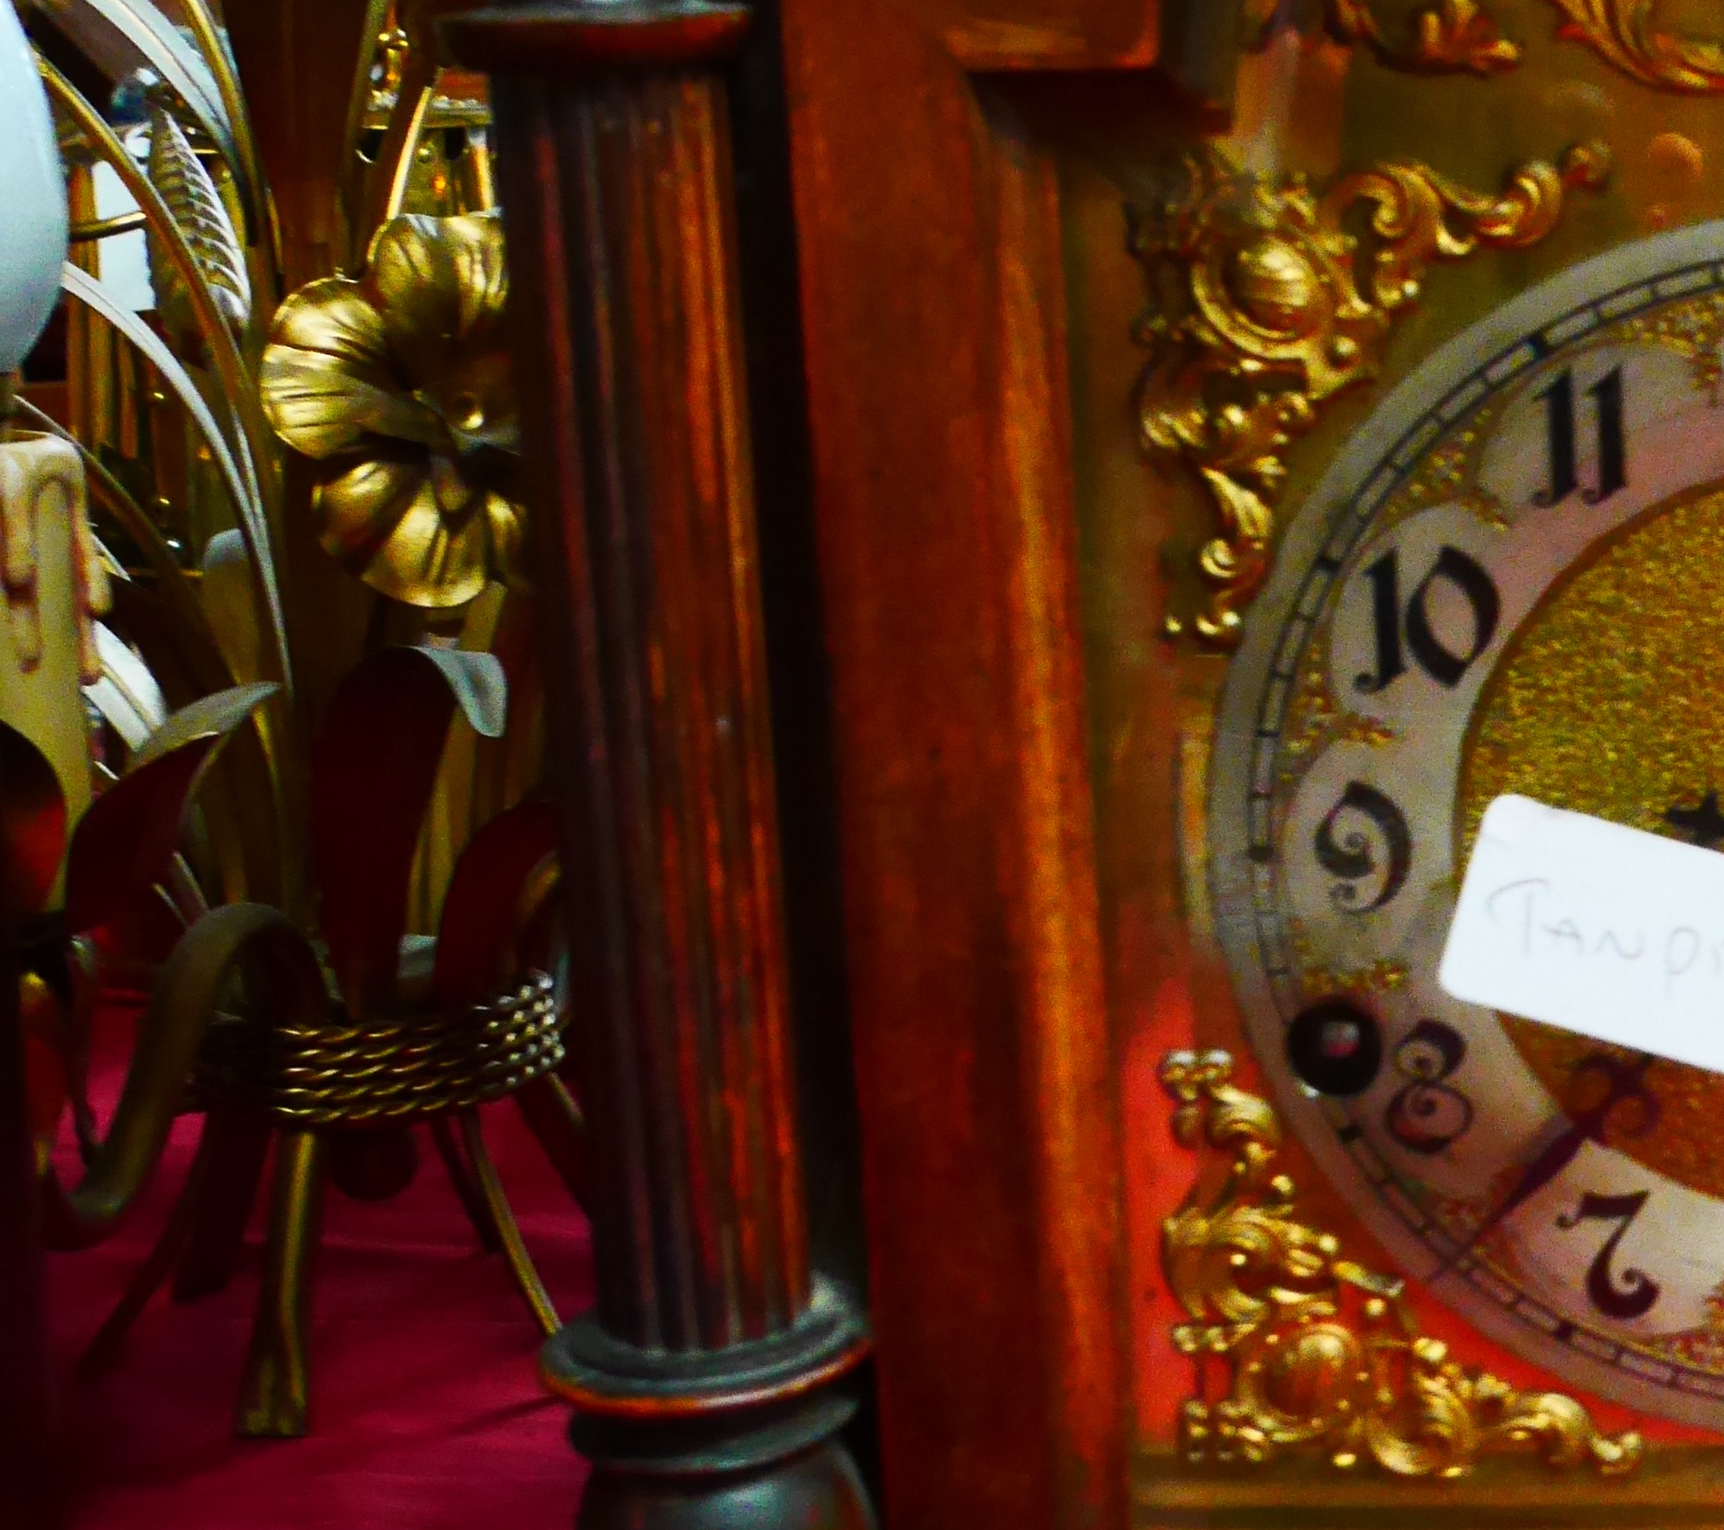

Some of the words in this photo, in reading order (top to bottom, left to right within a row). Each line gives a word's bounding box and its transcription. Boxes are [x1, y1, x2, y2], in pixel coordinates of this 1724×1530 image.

[1533, 361, 1627, 506] 11
[1356, 544, 1500, 694] 10
[1311, 781, 1412, 913] 9
[1387, 1020, 1476, 1156] 8
[1557, 1186, 1660, 1320] 7
